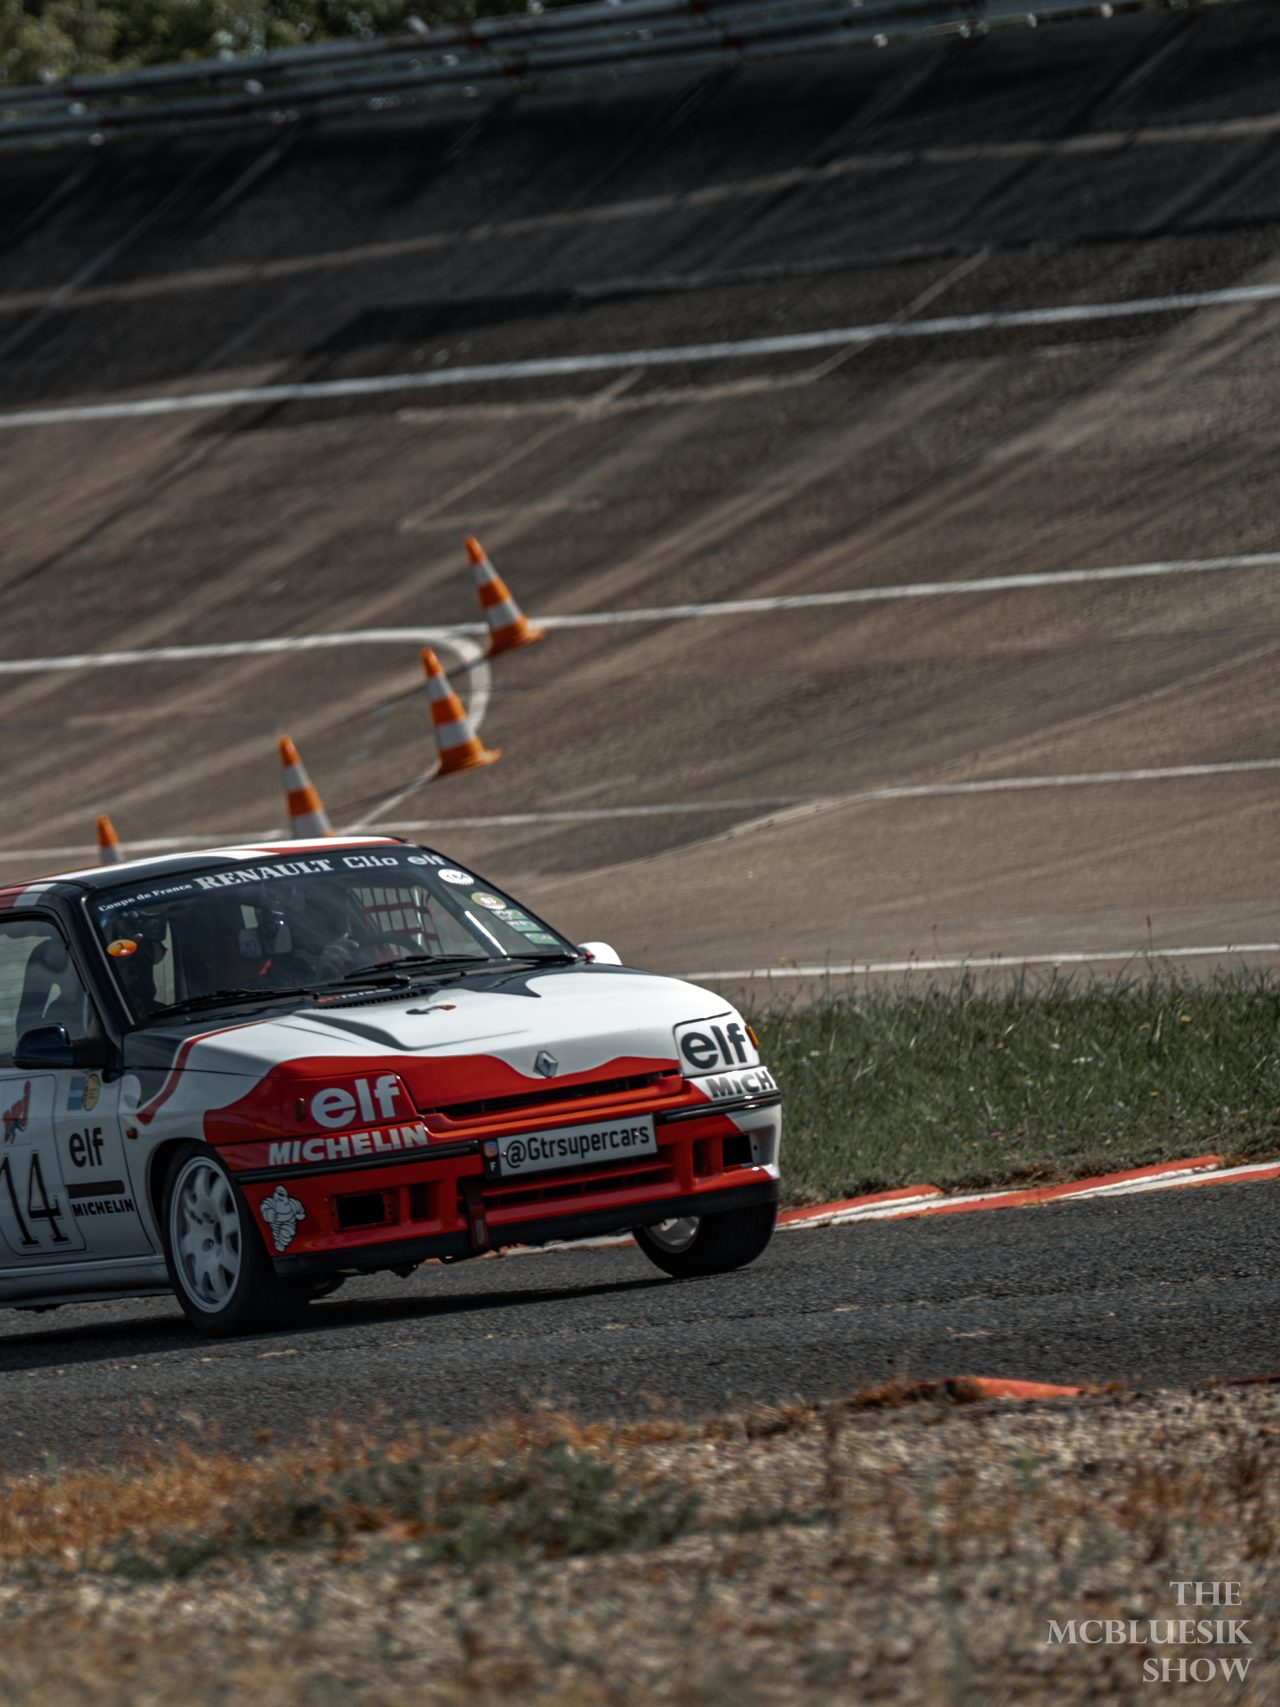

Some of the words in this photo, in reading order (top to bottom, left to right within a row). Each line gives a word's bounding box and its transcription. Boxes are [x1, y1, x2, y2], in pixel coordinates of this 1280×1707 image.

[98, 897, 135, 912] Coupe
[136, 892, 151, 902] de
[152, 883, 192, 898] France
[193, 859, 334, 890] RENAULT
[342, 855, 399, 869] Clio
[407, 854, 446, 866] elf
[680, 1023, 747, 1070] elf
[310, 1075, 400, 1128] elf
[69, 1127, 104, 1168] elf
[269, 1125, 429, 1166] MICHELIN
[505, 1126, 650, 1169] @Gtrsupercars
[72, 1199, 136, 1217] MICHELIN
